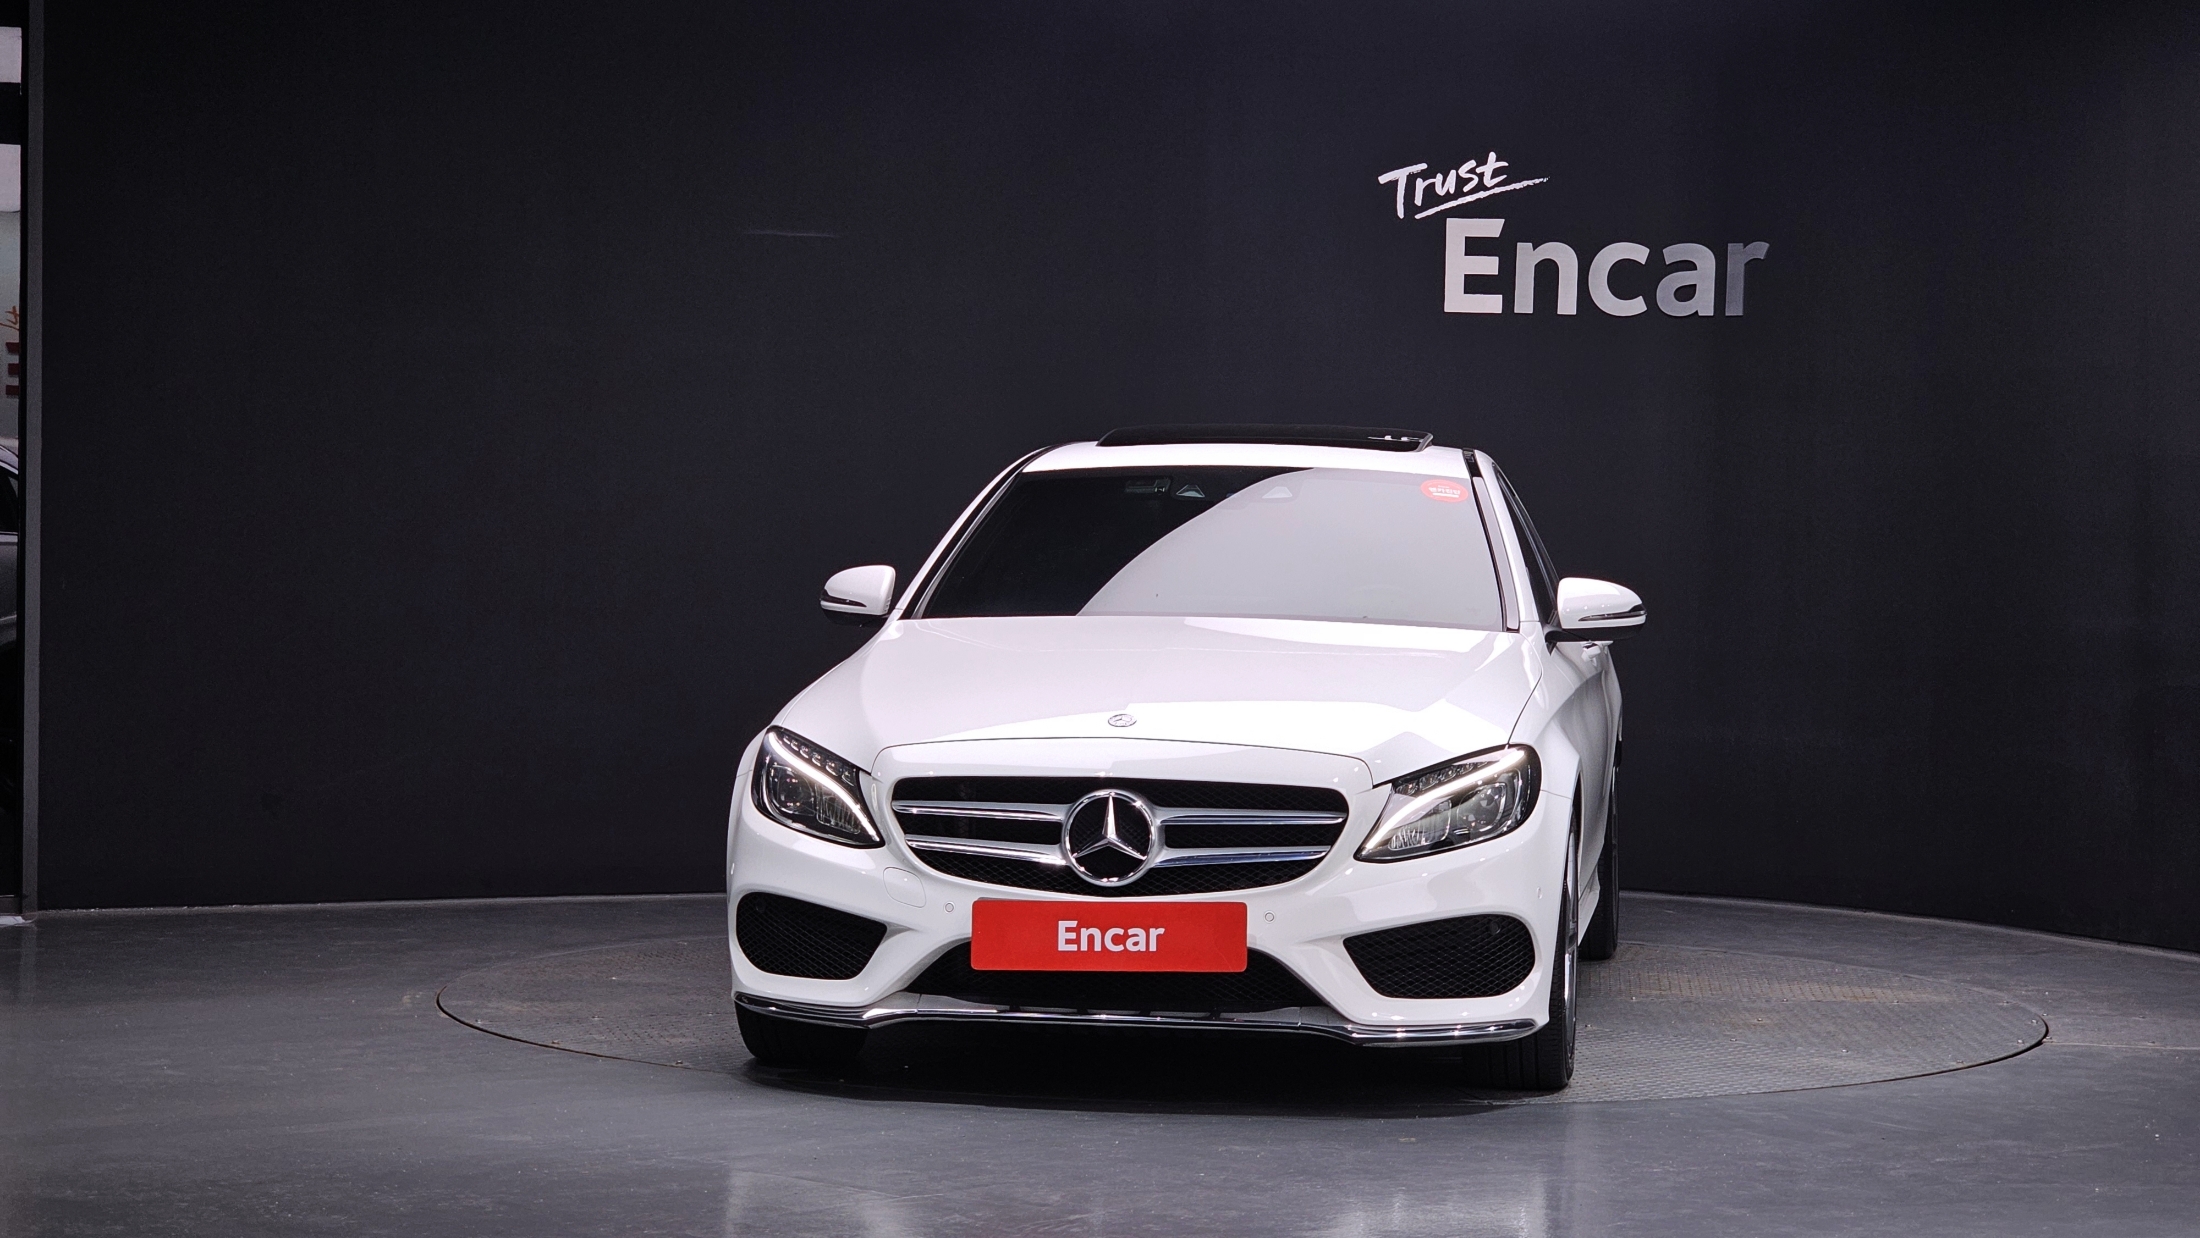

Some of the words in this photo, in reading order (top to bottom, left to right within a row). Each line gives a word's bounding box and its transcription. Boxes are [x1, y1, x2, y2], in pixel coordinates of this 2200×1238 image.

[1378, 151, 1509, 219] Trust
[1443, 217, 1770, 317] Encar
[1057, 920, 1165, 952] Encar
